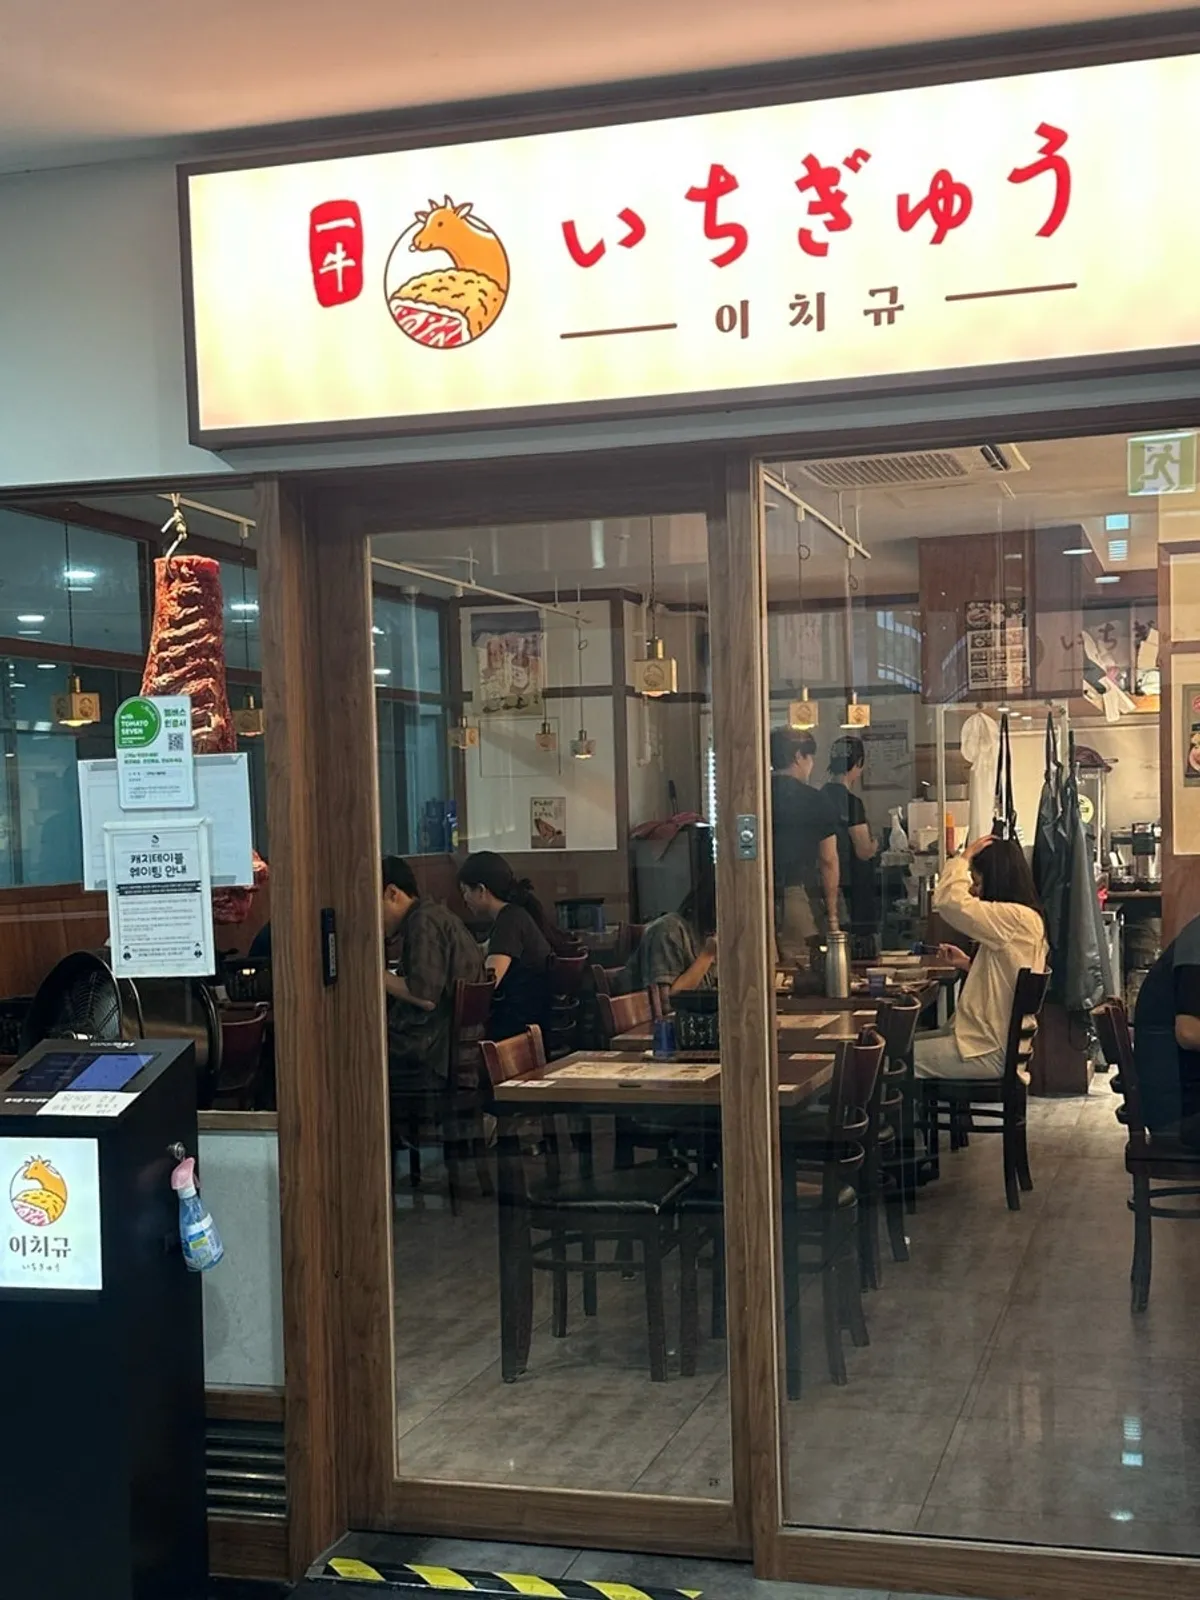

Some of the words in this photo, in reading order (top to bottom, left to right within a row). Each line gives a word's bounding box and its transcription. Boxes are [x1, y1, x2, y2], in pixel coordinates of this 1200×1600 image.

[562, 122, 1071, 268] いちぎゅう
[315, 217, 356, 293] 一牛
[121, 719, 149, 727] TOMATO
[121, 727, 143, 735] SEVEN
[130, 853, 184, 864] 캐치테이블
[164, 865, 187, 877] 안내
[9, 1235, 71, 1258] 이치규
